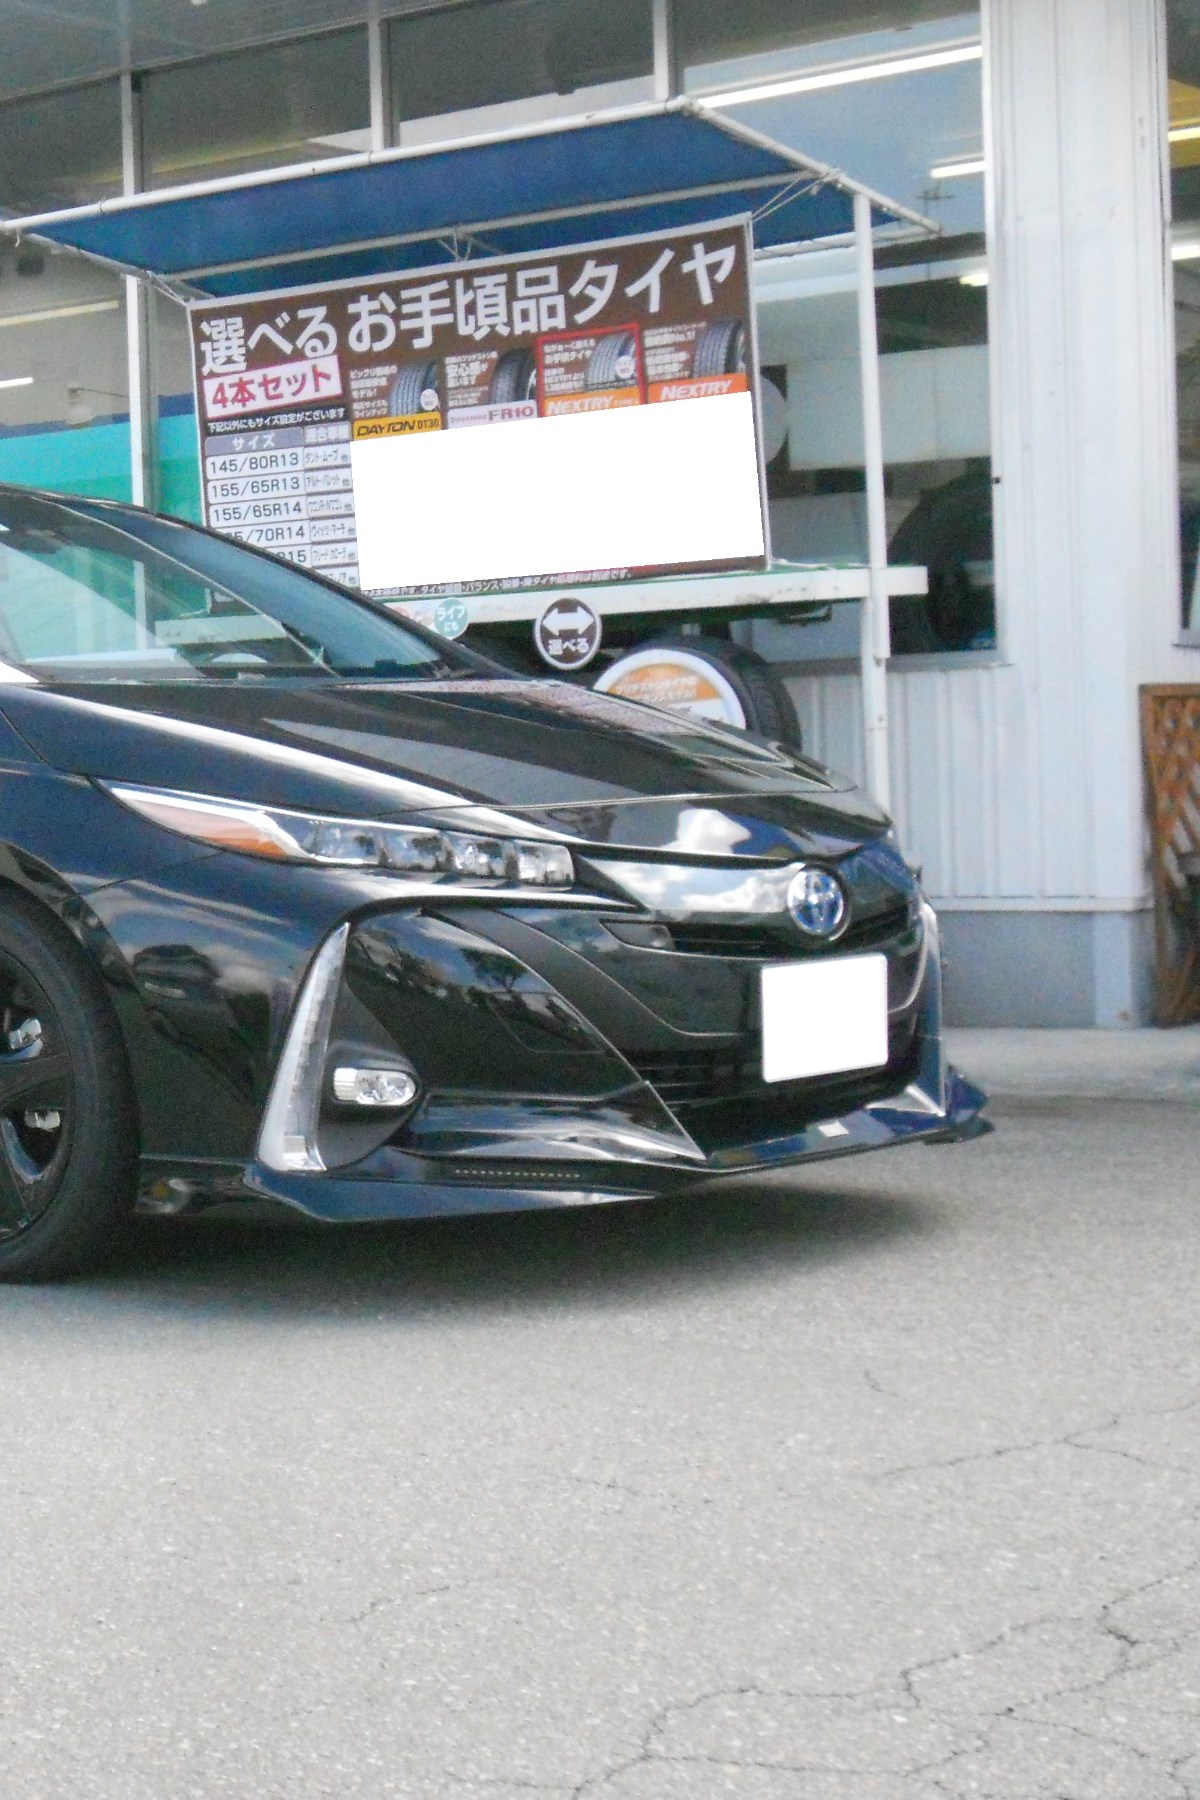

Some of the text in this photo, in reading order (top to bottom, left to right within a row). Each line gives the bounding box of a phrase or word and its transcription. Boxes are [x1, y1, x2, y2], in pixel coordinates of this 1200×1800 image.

[212, 364, 332, 408] 4本セット
[660, 380, 732, 401] NEXTRY
[488, 406, 535, 422] FR10
[357, 420, 417, 437] DAYTON
[232, 432, 276, 451] サイズ
[209, 452, 300, 474] 145/80R13
[211, 476, 301, 498] 155/65R13
[213, 501, 303, 522] 155/65R14
[437, 605, 465, 620] ライフ
